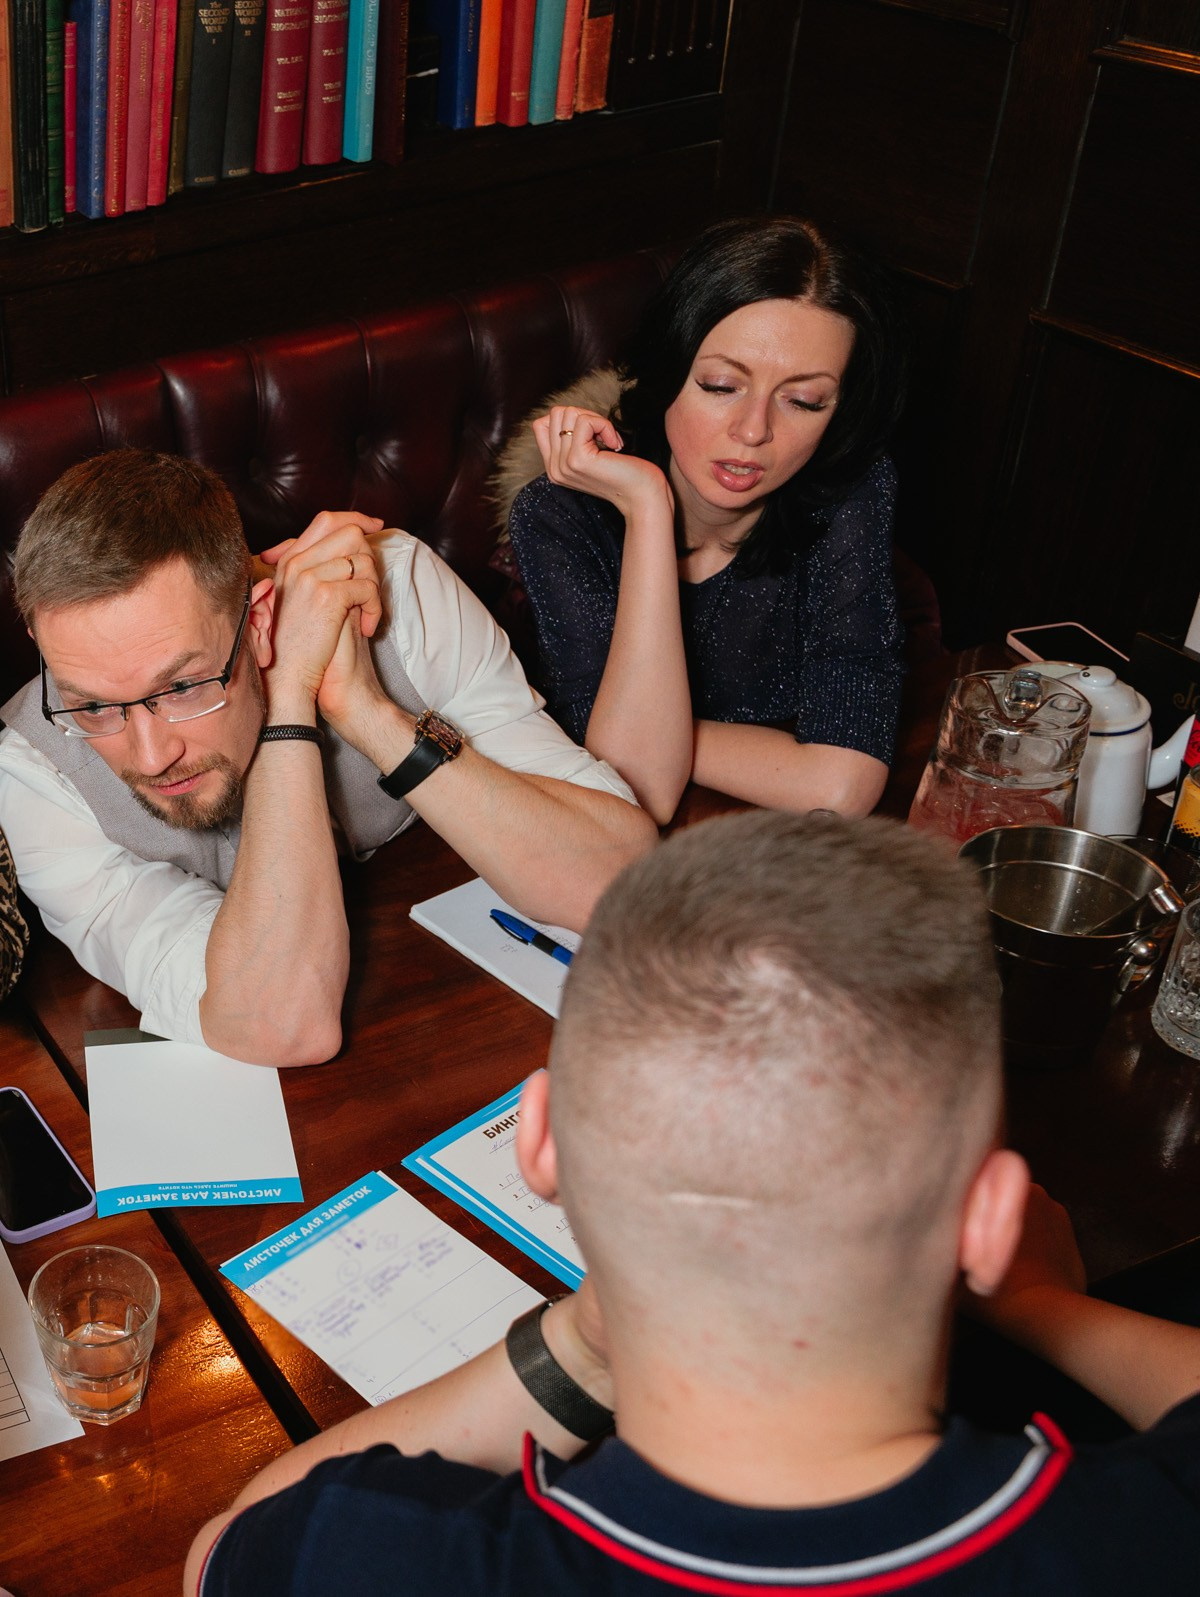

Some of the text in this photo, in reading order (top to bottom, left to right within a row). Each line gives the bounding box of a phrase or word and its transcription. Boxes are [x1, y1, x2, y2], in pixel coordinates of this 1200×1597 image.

[234, 1, 264, 9] SECOND
[198, 9, 230, 17] SECOND
[200, 17, 228, 25] WORLD
[205, 25, 223, 33] WAR
[364, 65, 373, 95] BIRDS
[117, 1188, 282, 1206] ЛИСТОЧЕК ДЛЯ ЗАМЕТОК
[243, 1231, 302, 1271] ЛИСТОЧЕК
[299, 1217, 324, 1237] ДЛЯ
[321, 1185, 372, 1220] ЗАМЕТОК
